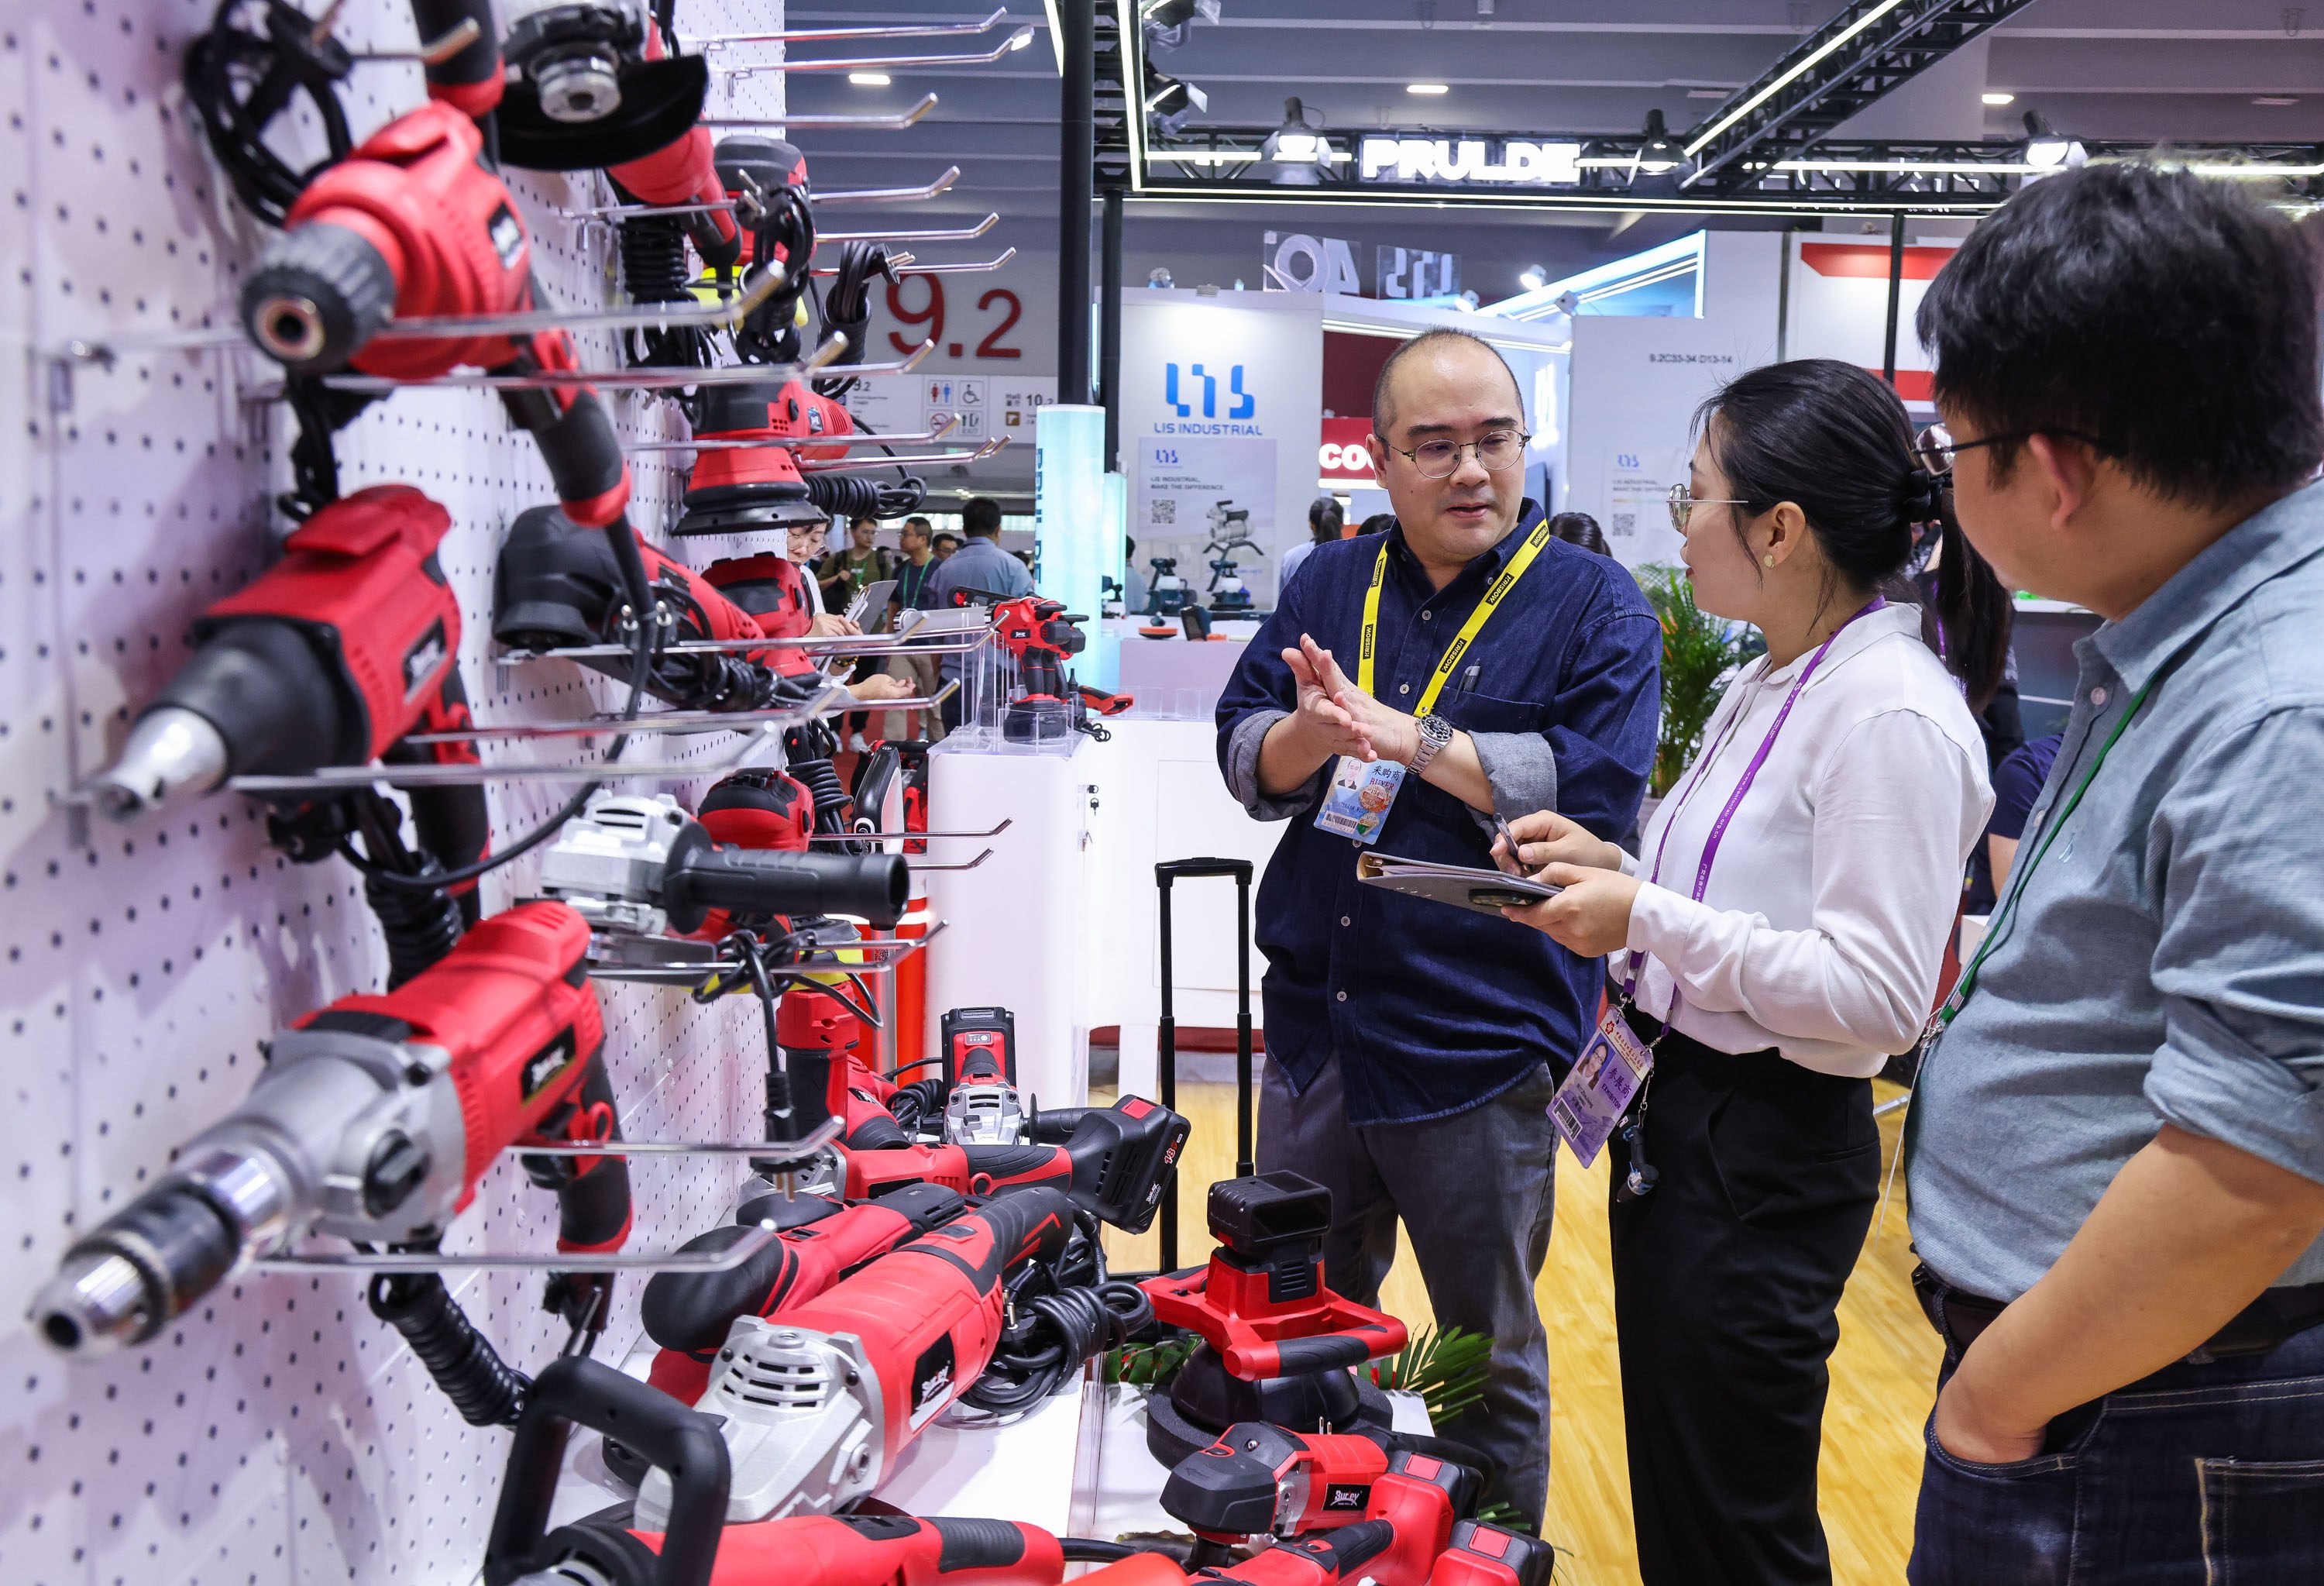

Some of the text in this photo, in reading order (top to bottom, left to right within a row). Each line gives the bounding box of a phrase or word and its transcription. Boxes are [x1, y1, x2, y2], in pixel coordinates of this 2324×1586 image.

[1363, 139, 1580, 182] PRULDE
[886, 272, 1021, 358] 9.2
[1153, 422, 1263, 435] LIS INDUSTRIAL
[1371, 765, 1401, 781] 采购商
[1601, 1082, 1622, 1111] EXHIBITOR
[1608, 1067, 1632, 1099] 参展商
